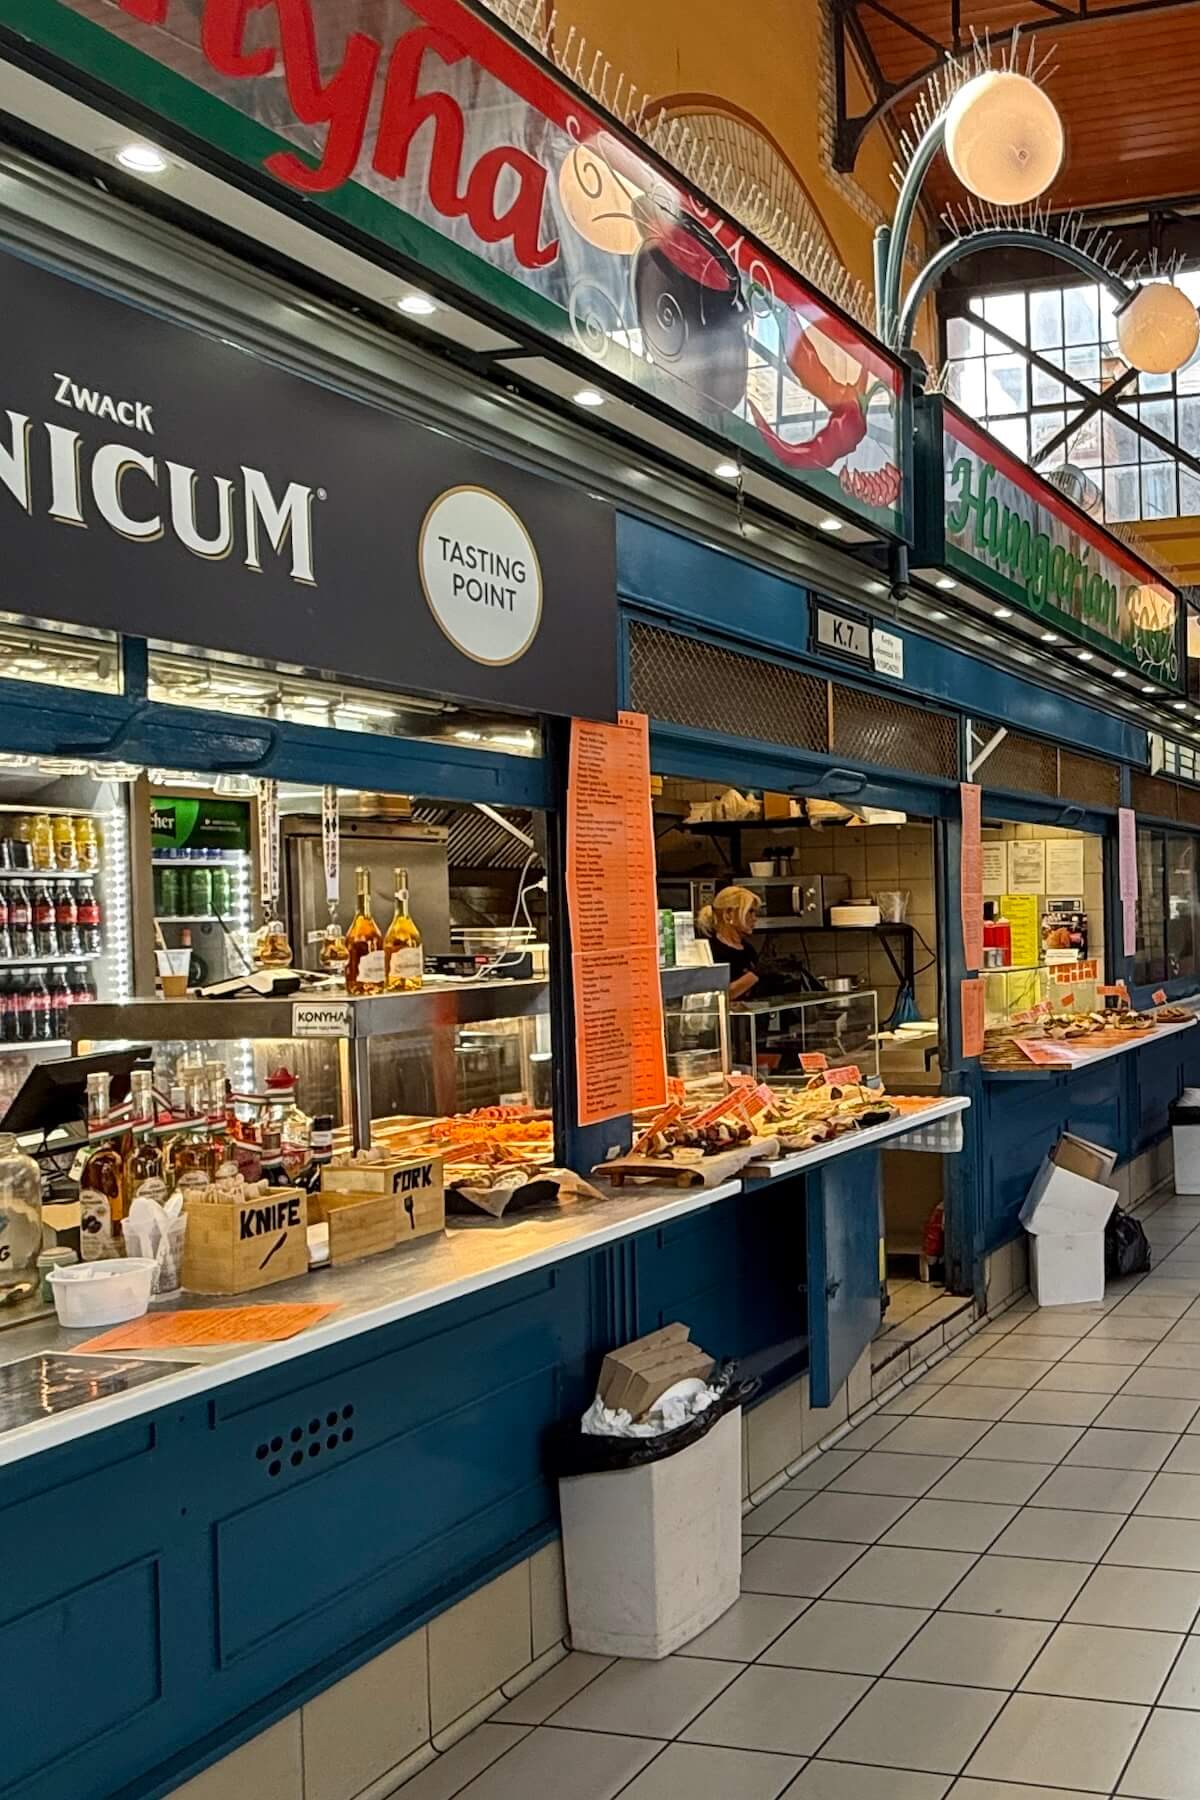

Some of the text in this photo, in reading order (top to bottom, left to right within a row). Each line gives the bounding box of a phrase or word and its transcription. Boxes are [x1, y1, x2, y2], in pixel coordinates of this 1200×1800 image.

[438, 535, 526, 583] TASTING
[947, 457, 1120, 635] Hungarian
[453, 573, 517, 611] POINT
[833, 619, 858, 650] K.7.
[392, 1163, 433, 1194] FORK
[240, 1199, 300, 1240] KNIFE
